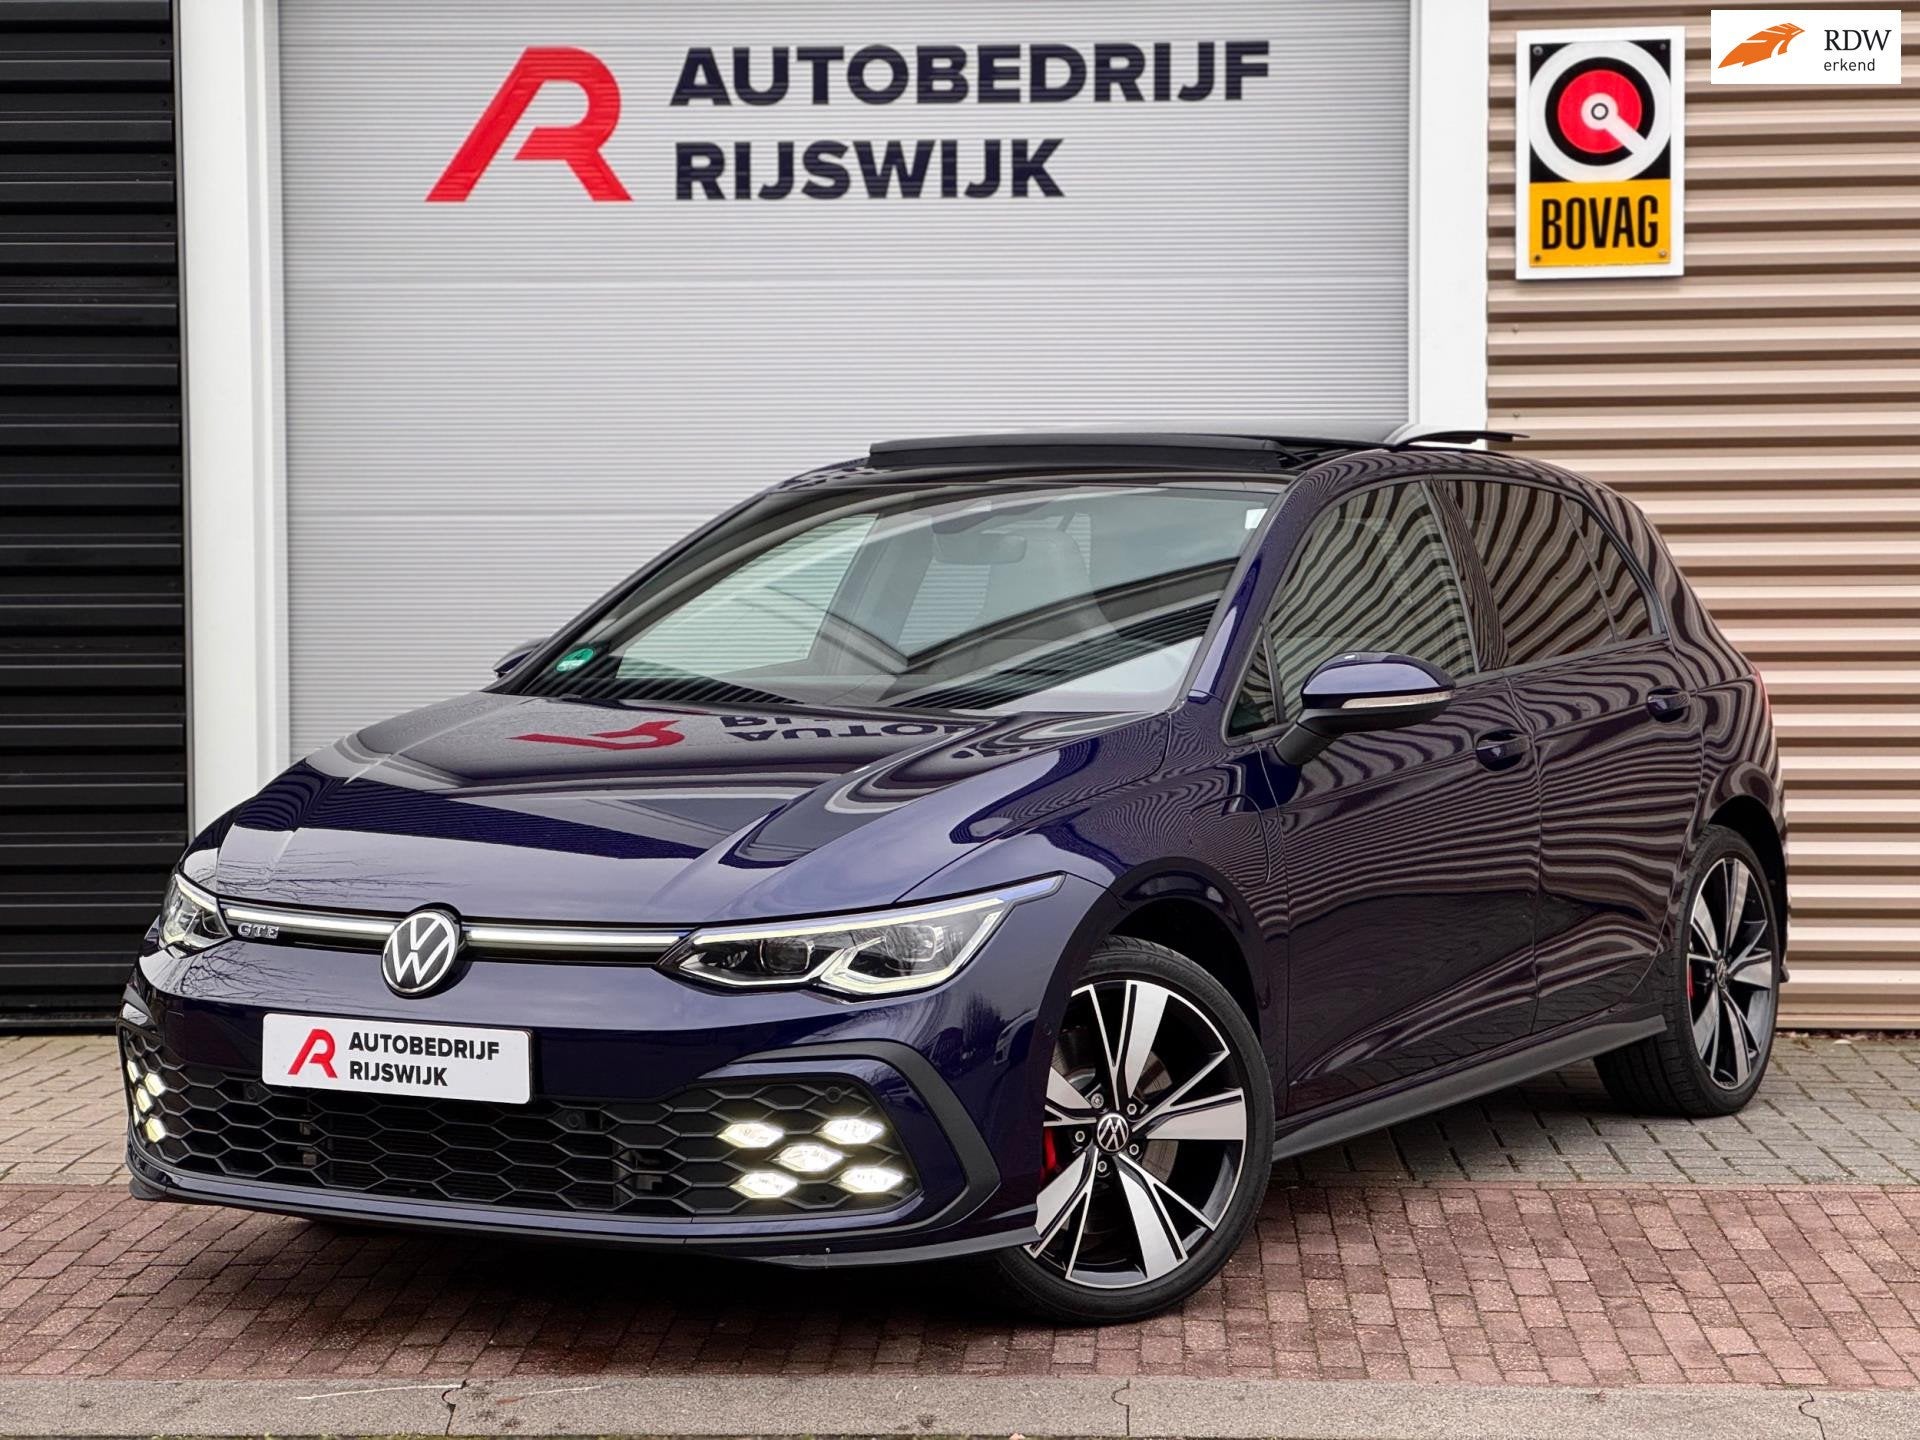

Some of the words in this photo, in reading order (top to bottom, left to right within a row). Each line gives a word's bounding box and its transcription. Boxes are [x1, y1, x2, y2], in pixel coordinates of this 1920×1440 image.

[669, 40, 1270, 107] AUTOBEDRIJF
[675, 138, 1065, 201] RIJSWIJK
[1541, 194, 1660, 251] BOVAG
[237, 922, 280, 940] GTE
[348, 1031, 500, 1061] AUTOBEDRIJF
[348, 1059, 449, 1088] RIJSWIJK
